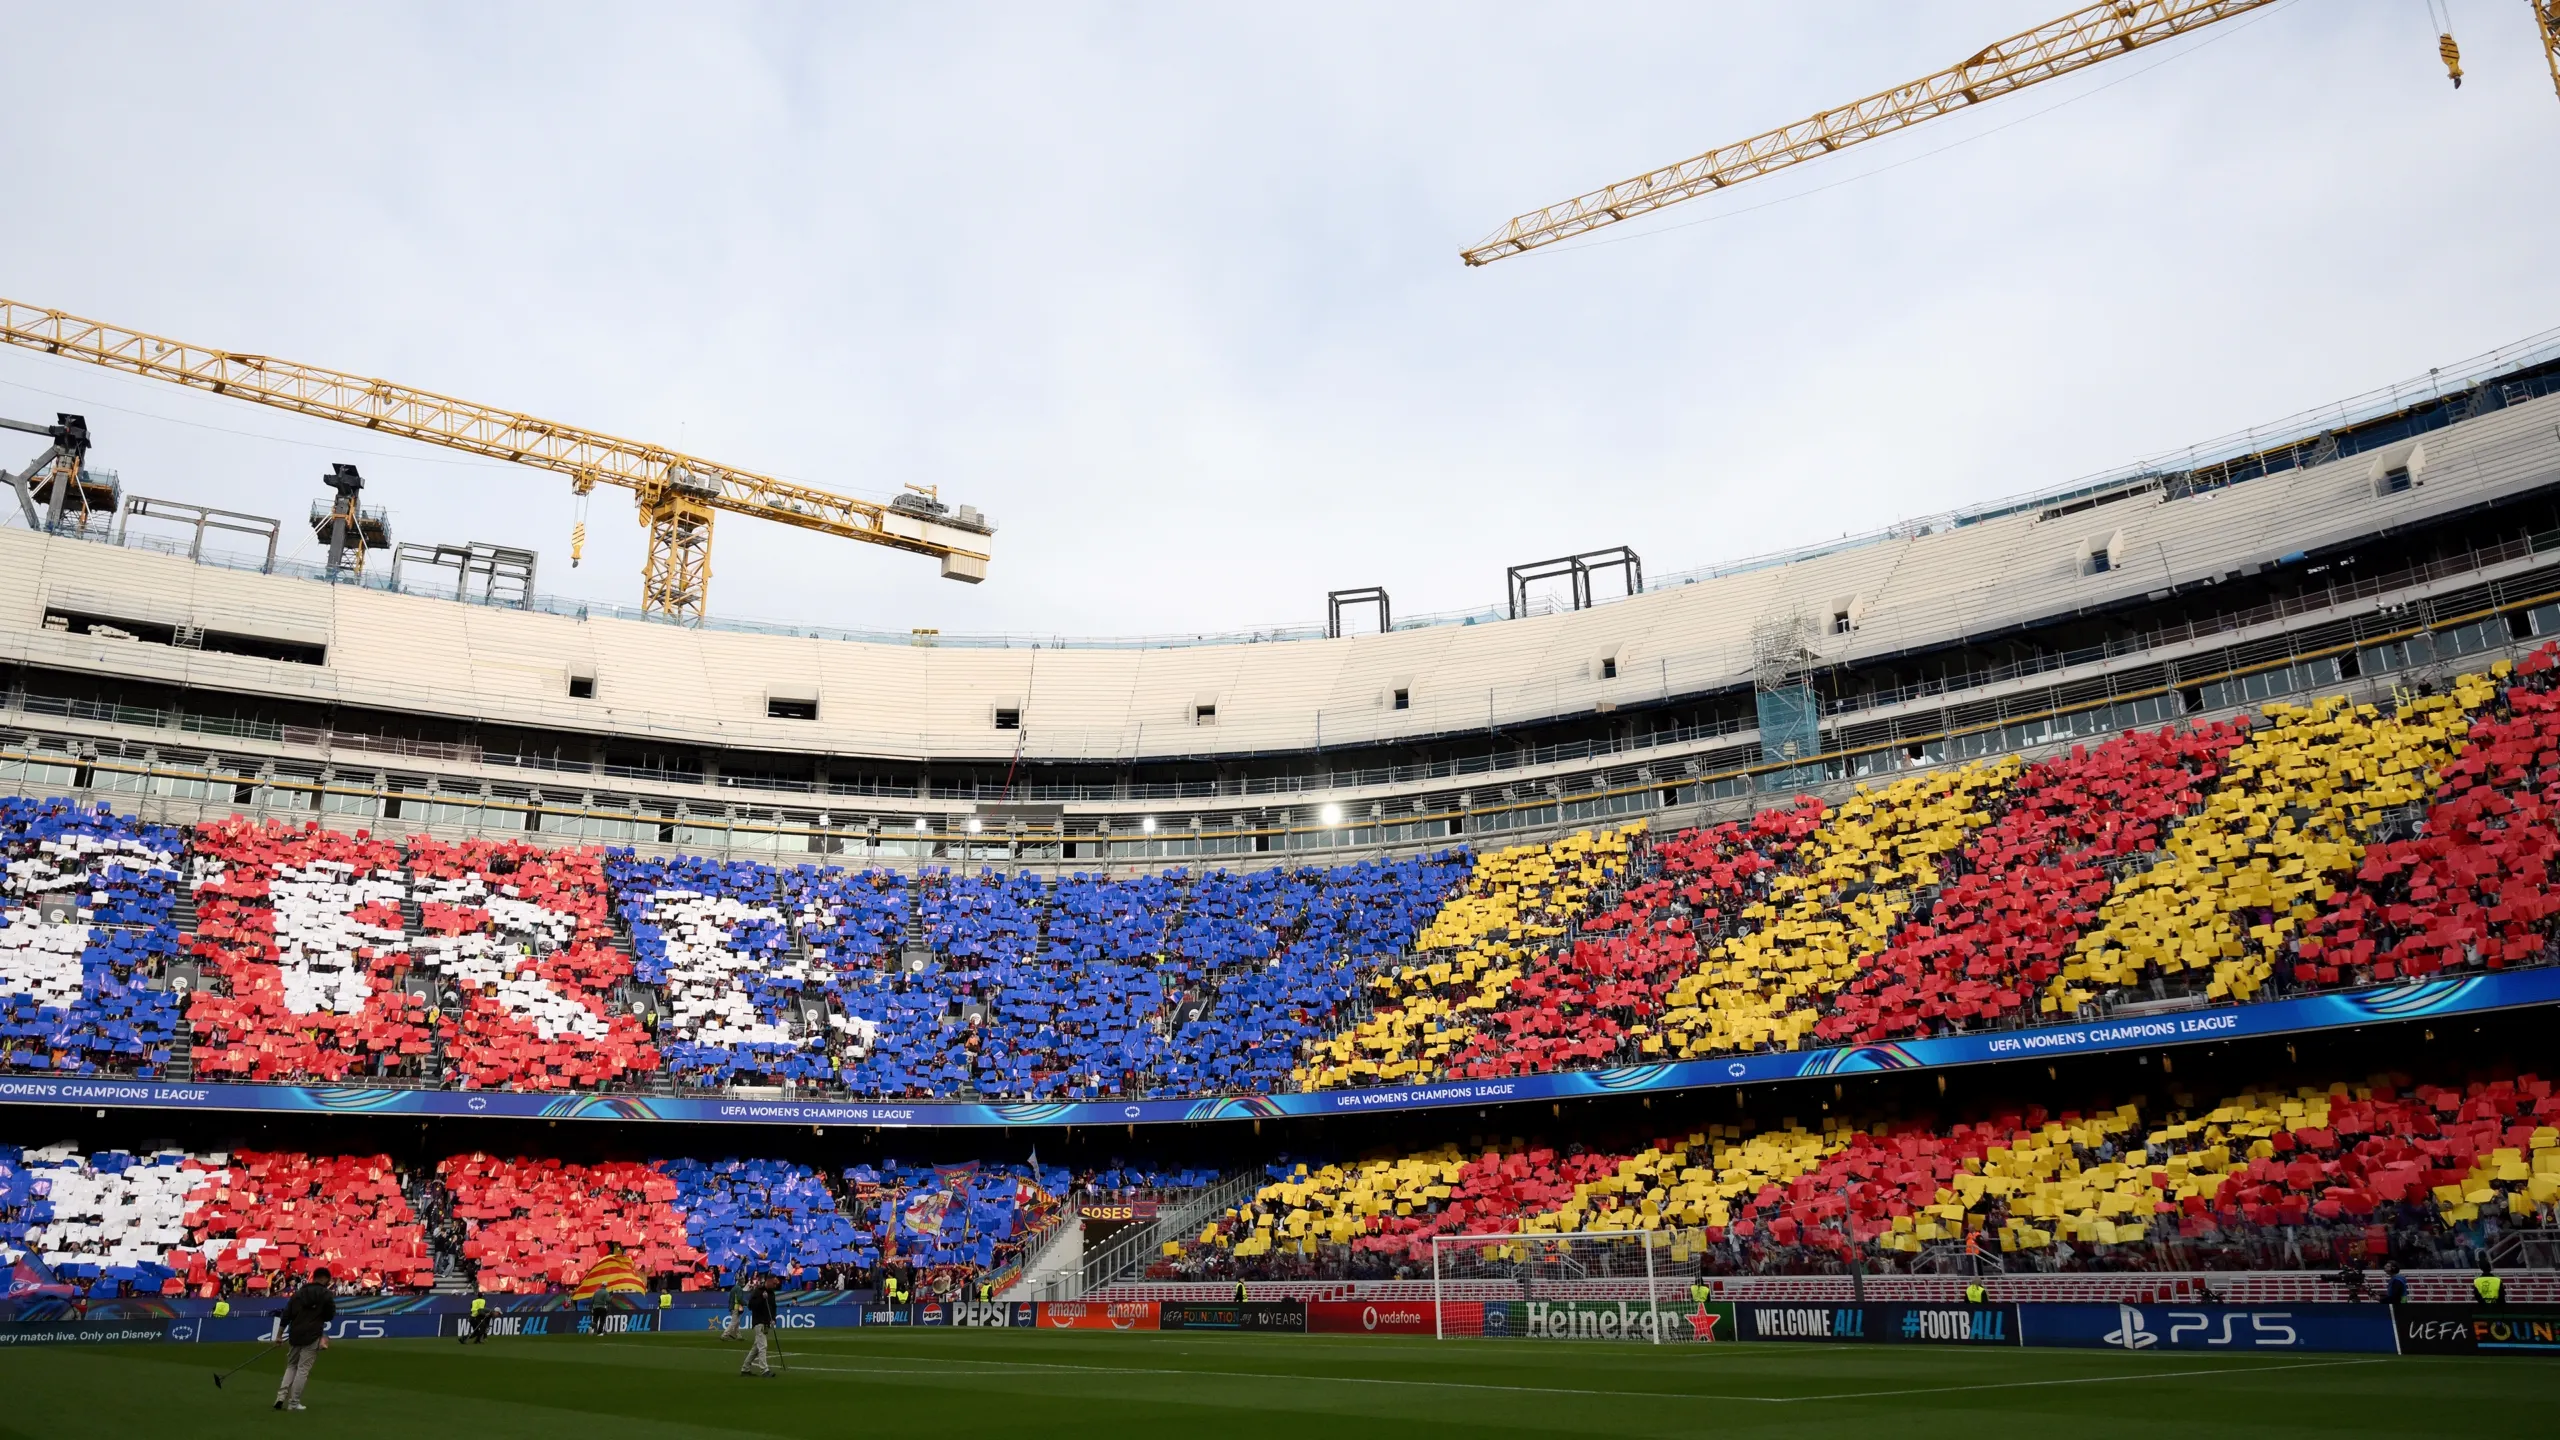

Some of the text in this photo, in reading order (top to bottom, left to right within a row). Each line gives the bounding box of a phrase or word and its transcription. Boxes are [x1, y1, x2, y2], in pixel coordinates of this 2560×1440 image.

[1989, 1015, 2236, 1052] UEFA WOMEN'S CHAMPIONS LEAGUE
[62, 1085, 149, 1099] CHAMPIONS
[154, 1088, 206, 1100] LEAGUE
[1337, 1084, 1514, 1106] UEFA WOMEN'S CHAMPIONS LEAGUE
[721, 1105, 913, 1119] UEFA WOMEN'S CHAMPIONS LEAGUE
[1081, 1207, 1132, 1219] SOSES
[864, 1310, 909, 1322] #FOOTBALL
[952, 1301, 1011, 1327] PEPSI
[1048, 1303, 1087, 1318] amazon
[1107, 1303, 1149, 1318] amazon
[1163, 1310, 1183, 1322] UEFA
[1379, 1311, 1421, 1324] vodafone
[523, 1316, 549, 1335] ALL
[1526, 1301, 1680, 1339] Heineken
[1755, 1308, 1865, 1337] WELCOME ALL
[1902, 1309, 2005, 1340] #FOOTBALL
[2168, 1312, 2297, 1345] PS5
[0, 1329, 162, 1342] ery match live. Only on Disney+
[2409, 1320, 2469, 1341] UEFA
